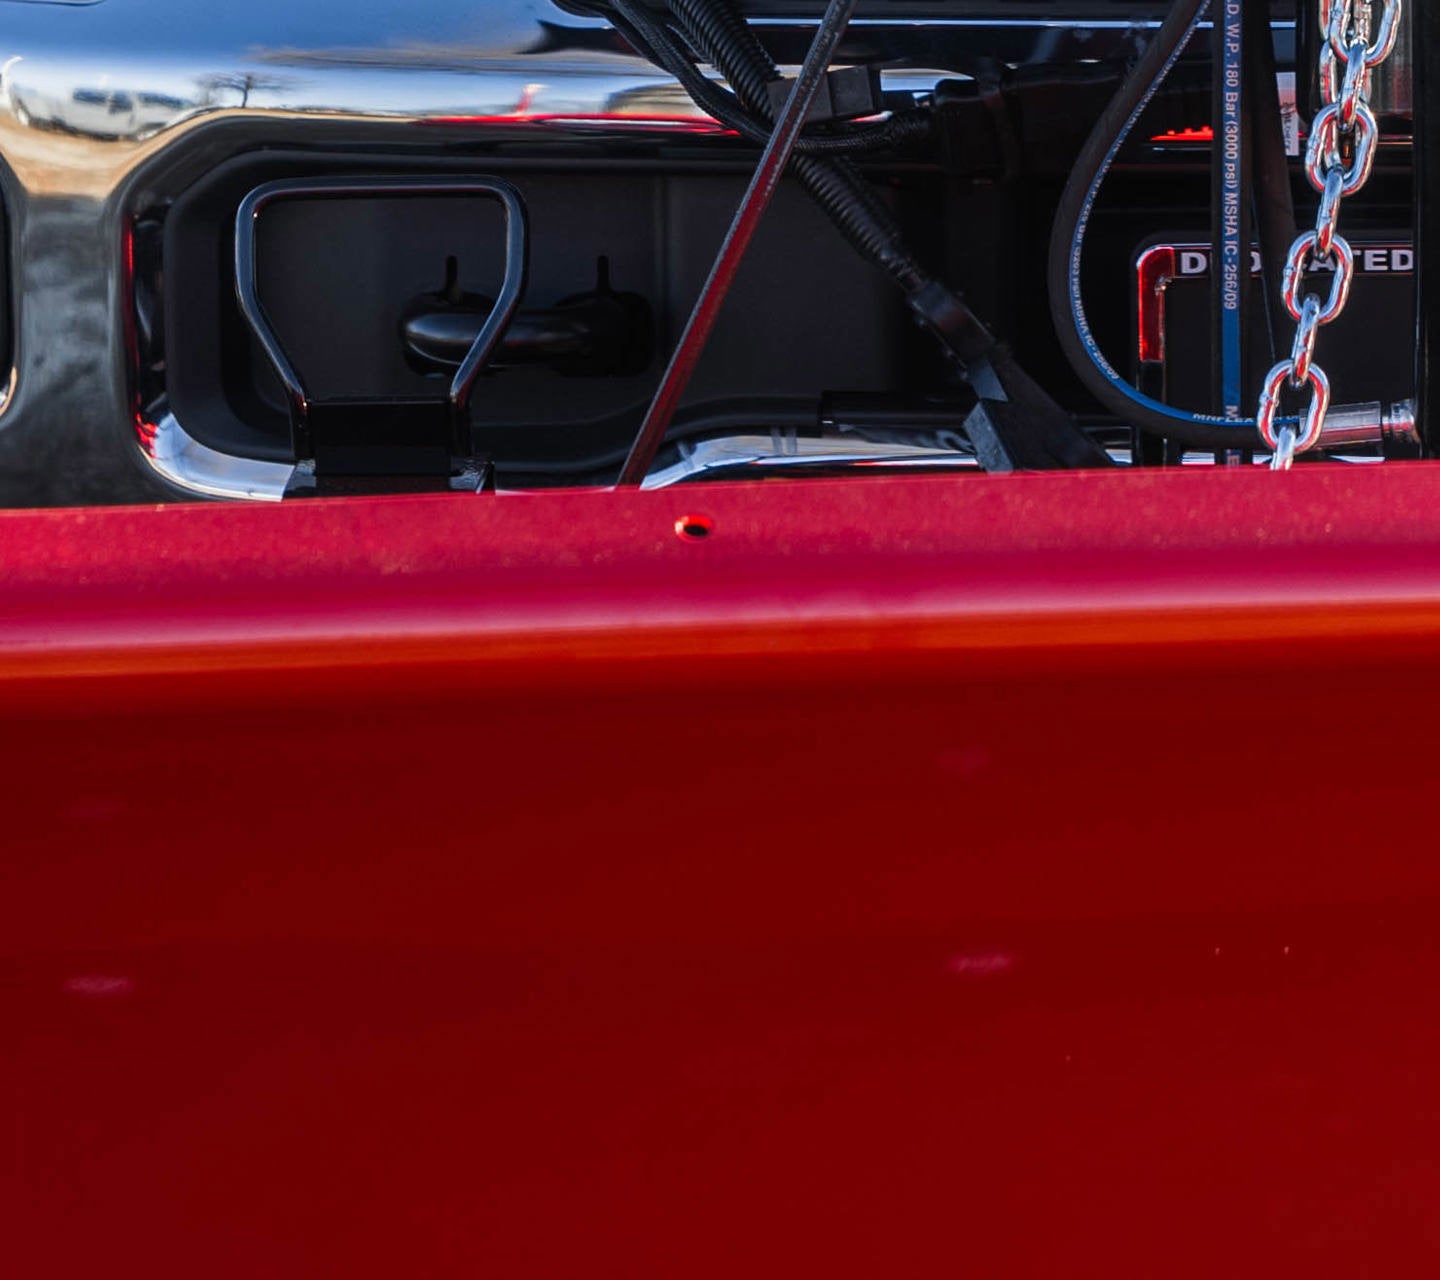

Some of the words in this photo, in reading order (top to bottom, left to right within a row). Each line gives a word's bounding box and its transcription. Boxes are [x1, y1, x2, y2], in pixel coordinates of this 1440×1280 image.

[1225, 24, 1239, 57] W.P.
[1226, 62, 1238, 87] 180
[1225, 92, 1238, 118] Bar
[1224, 193, 1238, 237] MSHA
